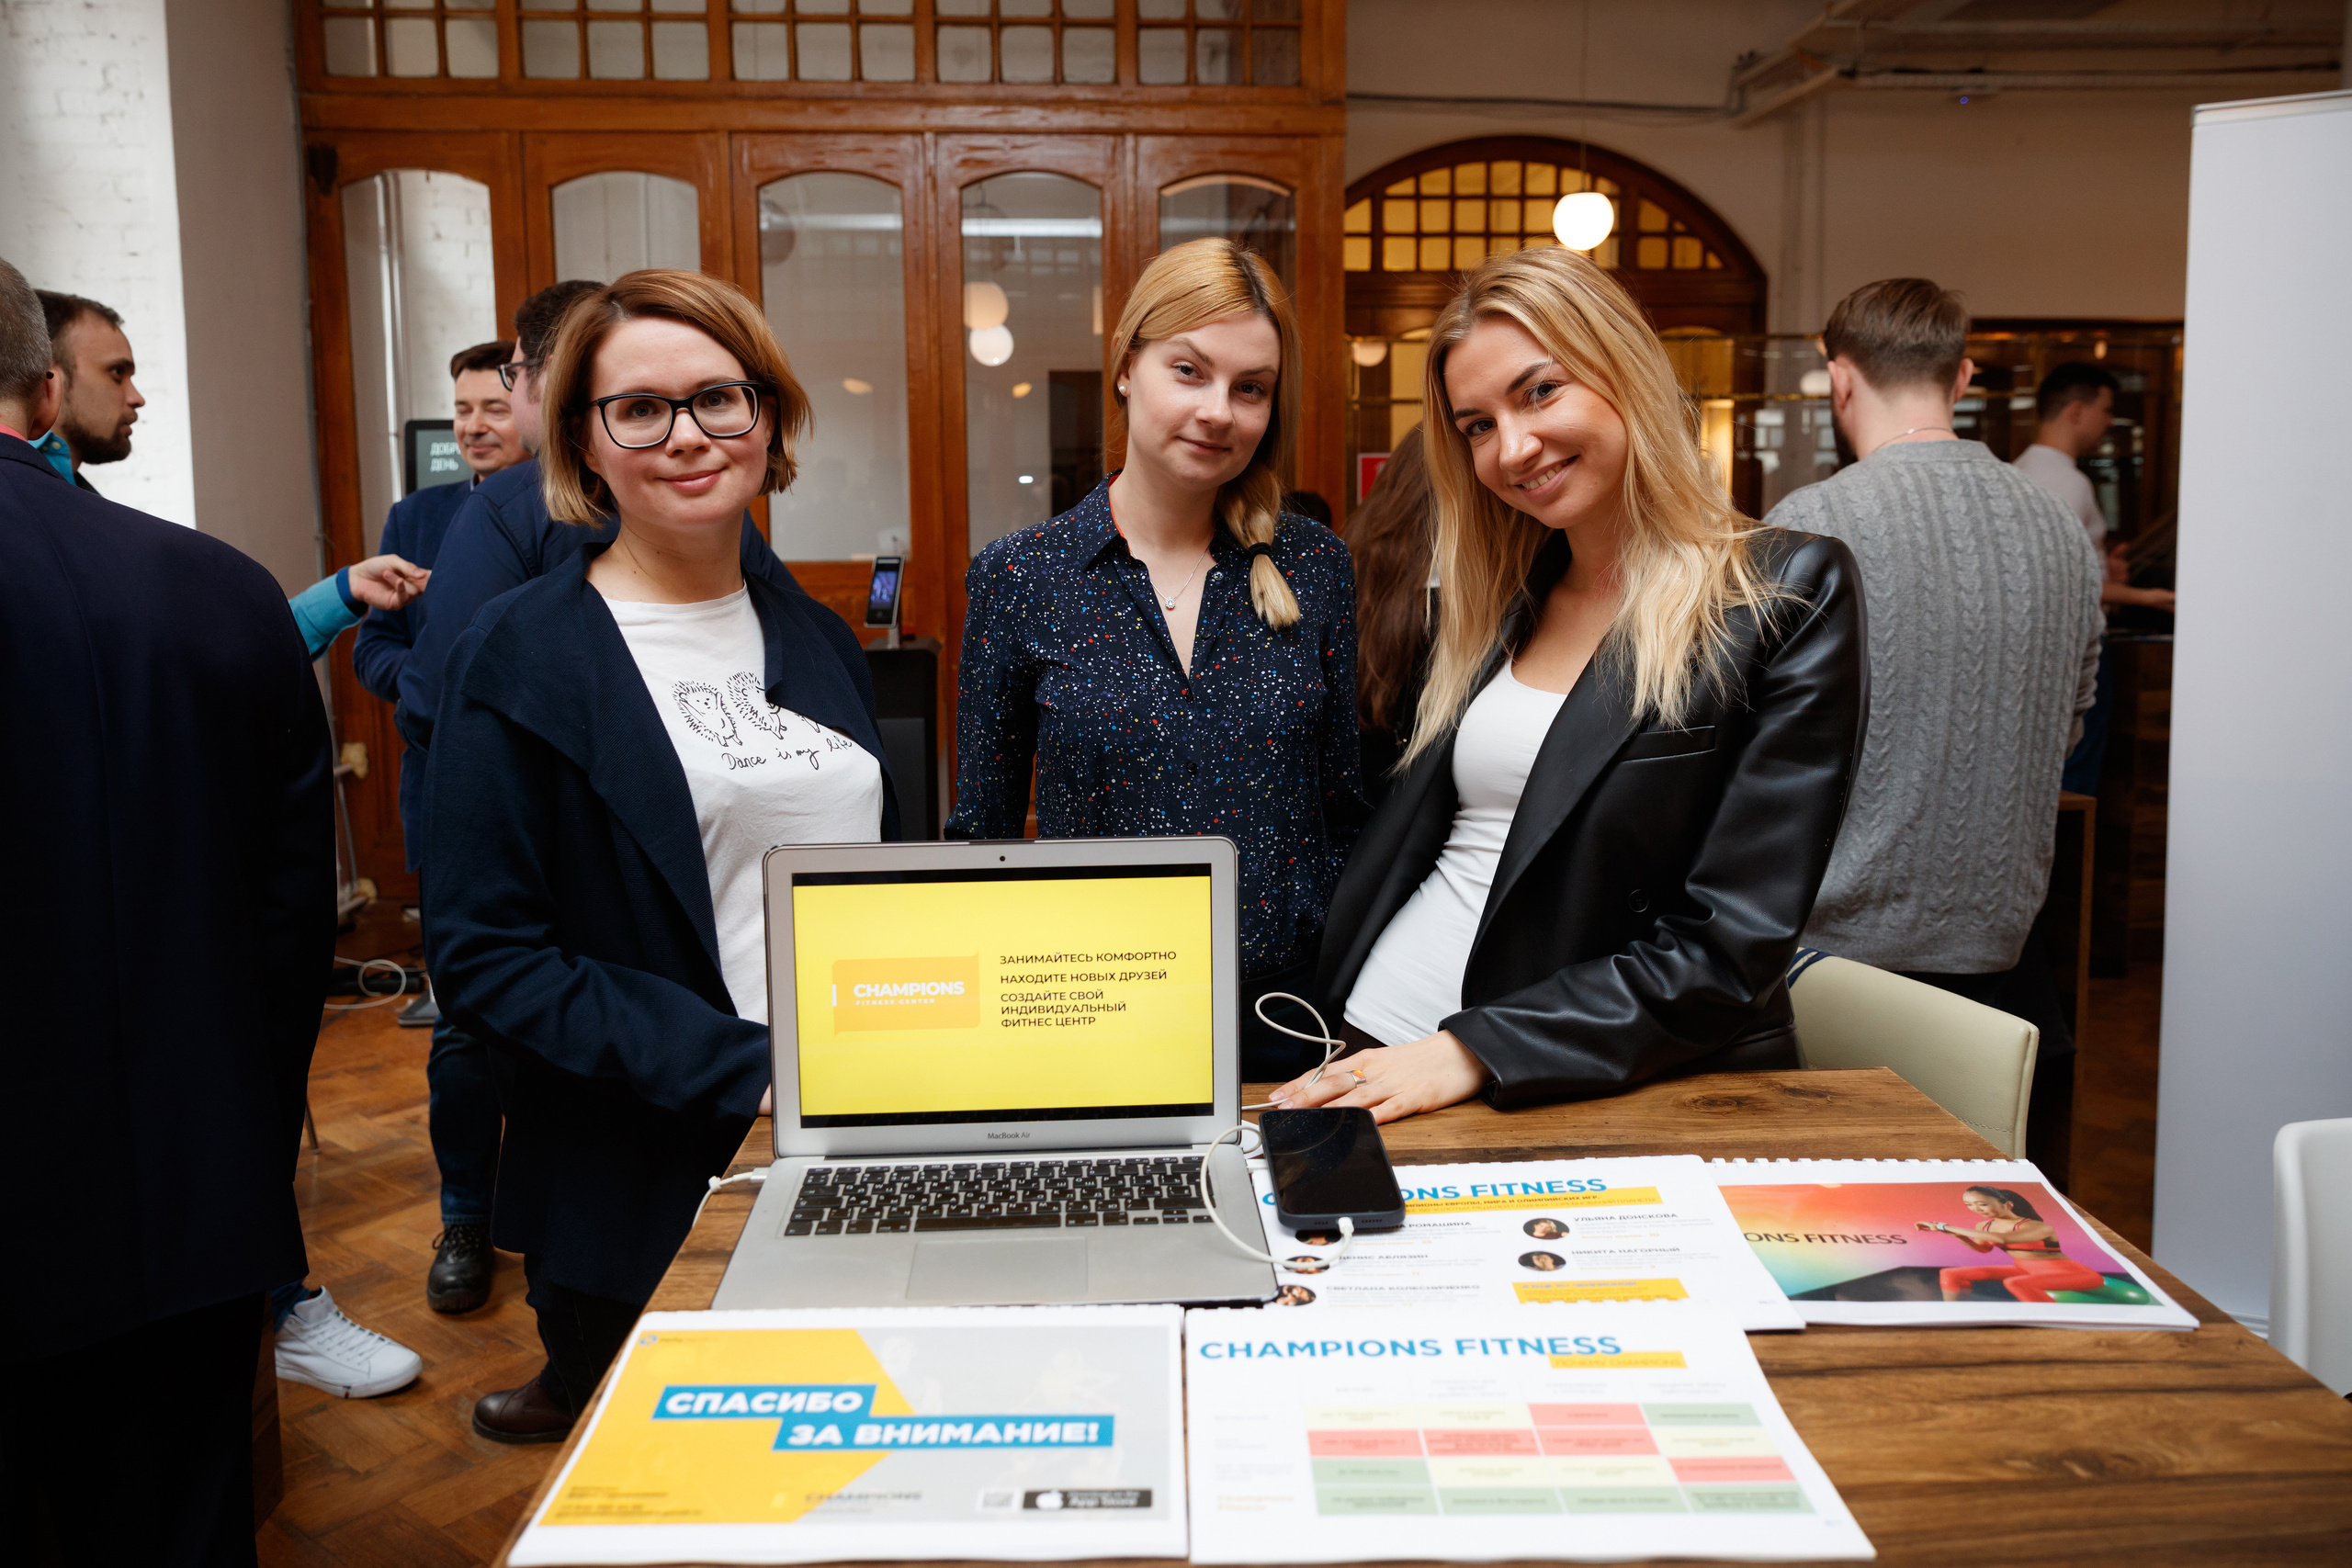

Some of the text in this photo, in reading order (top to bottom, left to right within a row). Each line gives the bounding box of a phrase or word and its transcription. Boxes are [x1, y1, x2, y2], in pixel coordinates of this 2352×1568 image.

[430, 442, 461, 457] ДОБР
[430, 458, 459, 472] ДЕНЬ
[721, 735, 852, 770] Dance is my life
[1000, 951, 1177, 964] ЗАНИМАЙТЕСЬ КОМФОРТНО
[1001, 969, 1167, 984] НАХОДИТЕ НОВЫХ ДРУЗЕЙ
[853, 981, 966, 998] CHAMPIONS
[1001, 989, 1103, 1003] СОЗДАЙТЕ СВОЙ
[1001, 1000, 1126, 1016] ИНДИВИДУАЛЬНЫЙ
[1001, 1016, 1096, 1028] ФИТНЕС ЦЕНТР
[1470, 1179, 1607, 1198] FITNESS
[1516, 1195, 1580, 1203] ОЛИМПИЙСКИХ
[1619, 1213, 1679, 1221] ДОНСКОВА
[1804, 1234, 1908, 1245] FITNESS
[1619, 1246, 1680, 1254] НАГОРНЫЙ
[1199, 1336, 1623, 1359] CHAMPIONS FITNESS
[665, 1391, 864, 1415] СПАСИБО
[786, 1422, 1100, 1446] ЗА ВНИМАНИЕ!
